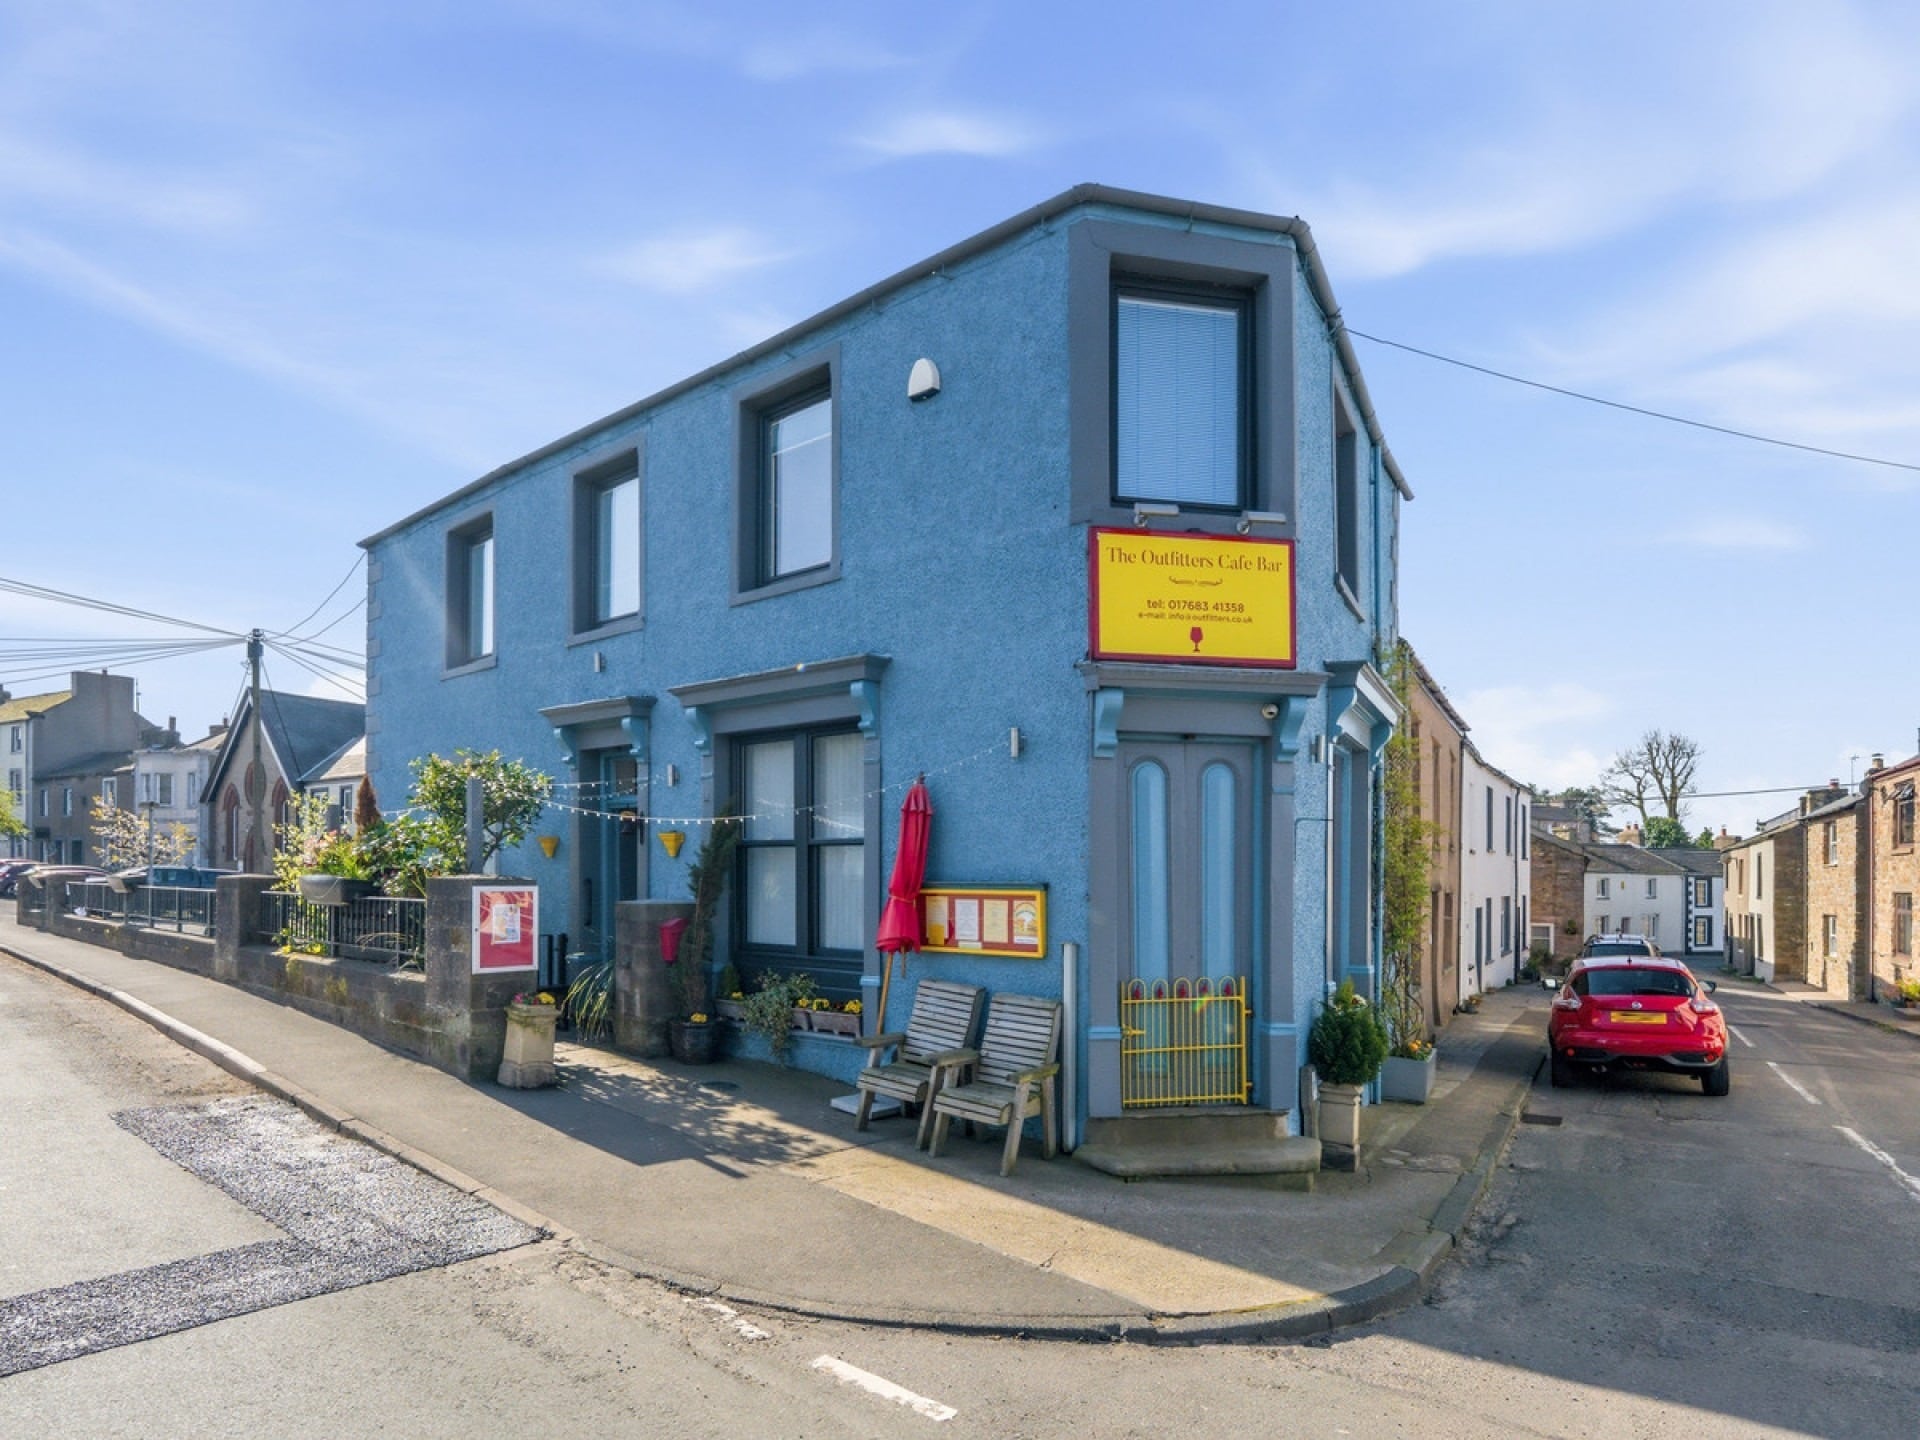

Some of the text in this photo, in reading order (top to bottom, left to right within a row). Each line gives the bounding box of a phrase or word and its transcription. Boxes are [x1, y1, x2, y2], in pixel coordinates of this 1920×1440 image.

[1106, 547, 1283, 572] The Outfitters Cafe Bar
[1146, 599, 1245, 613] tel: 017683 41358
